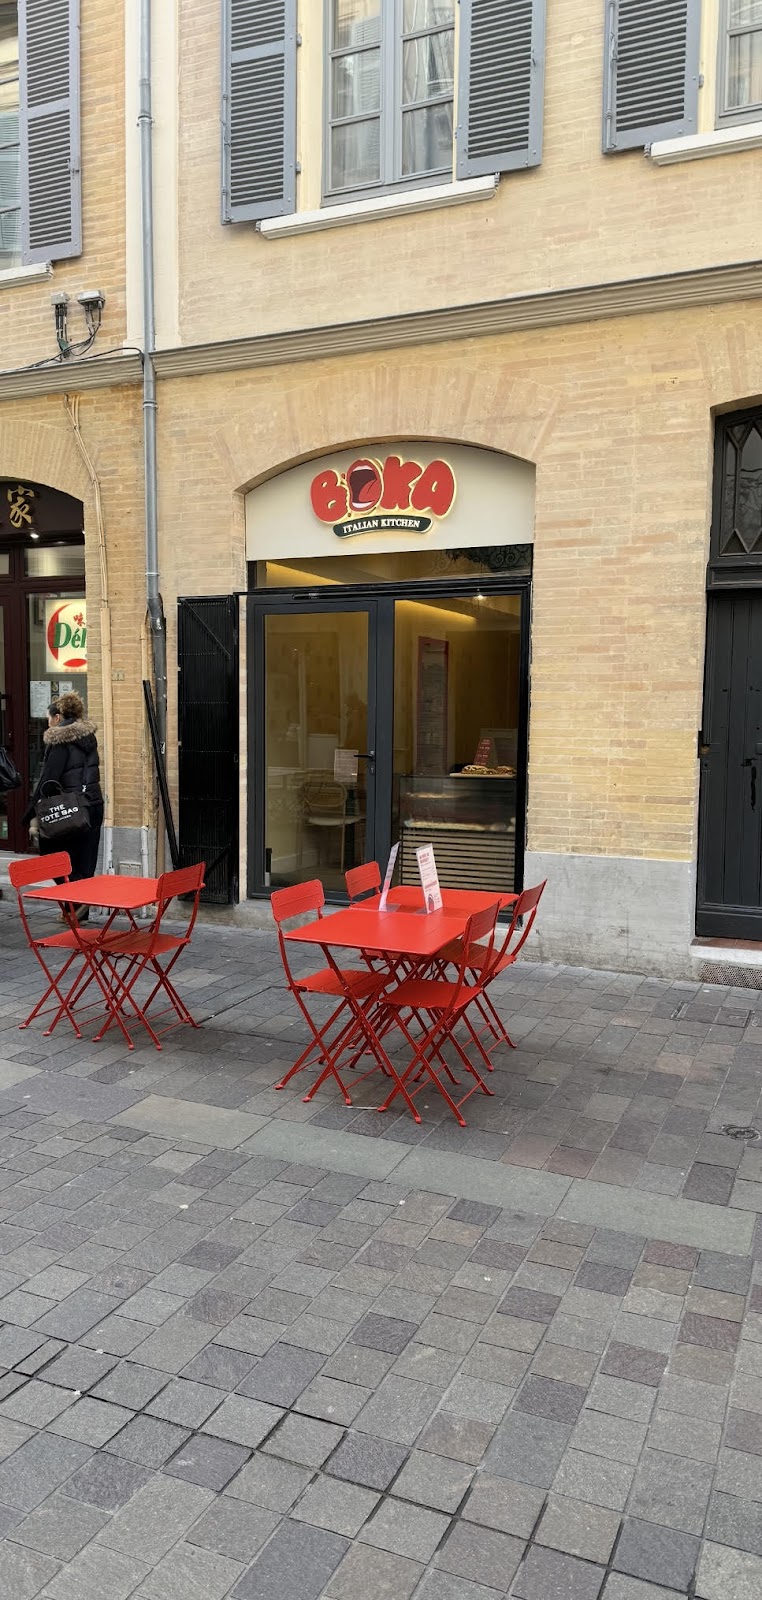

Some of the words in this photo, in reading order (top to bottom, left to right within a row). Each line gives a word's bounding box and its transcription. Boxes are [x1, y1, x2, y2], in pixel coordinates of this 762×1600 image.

[310, 455, 455, 522] BOKA
[343, 519, 379, 534] ITALIAN
[380, 518, 420, 528] KITCHEN
[40, 812, 60, 822] TOTE
[61, 806, 78, 816] BAG
[49, 804, 65, 813] THE
